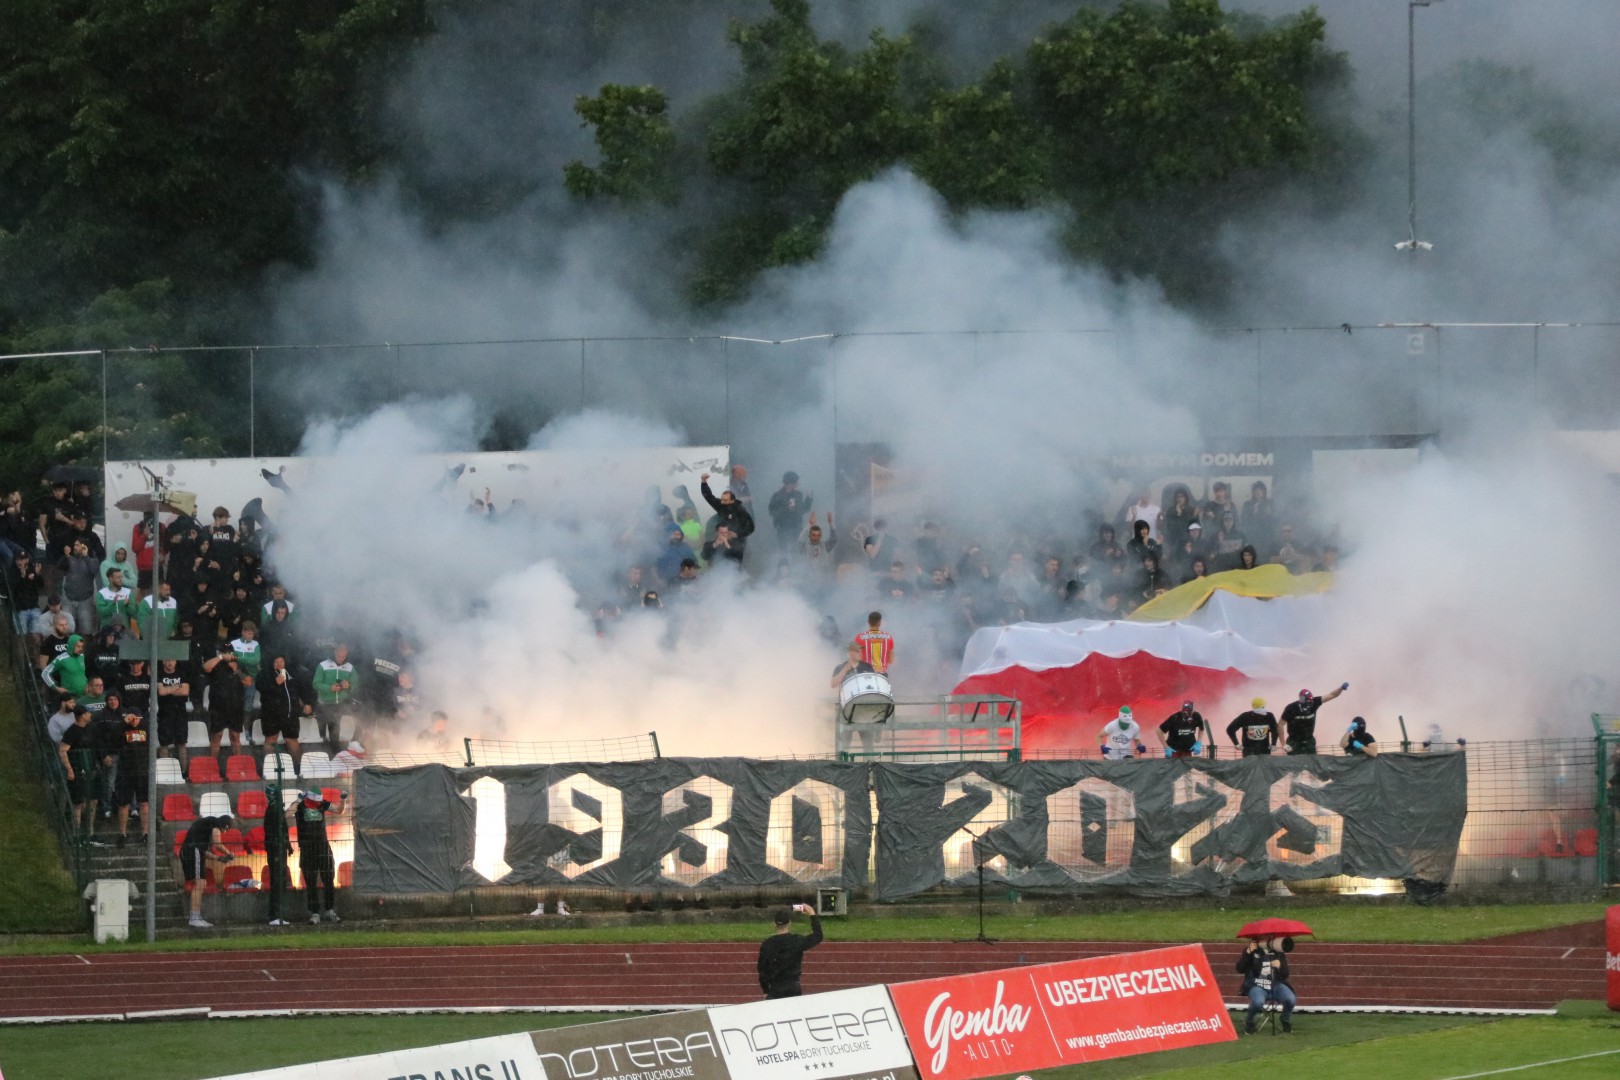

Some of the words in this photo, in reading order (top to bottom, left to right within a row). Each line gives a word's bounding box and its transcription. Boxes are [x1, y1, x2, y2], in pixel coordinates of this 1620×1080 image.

[1201, 453, 1274, 467] DOMEM
[460, 772, 846, 887] 1930
[1044, 963, 1206, 1007] UBEZPIECZENIA
[720, 1006, 893, 1056] NOTERA
[923, 980, 1032, 1075] Gemba
[1065, 1013, 1222, 1049] www.gembaubezpieczenia.pl
[539, 1030, 718, 1079] NOTERA
[642, 1065, 695, 1080] TUCHOLSKIE
[756, 1051, 785, 1066] HOTEL
[785, 1050, 800, 1062] SPA
[800, 1046, 823, 1060] BORY
[822, 1040, 872, 1057] TUCHOLSKIE
